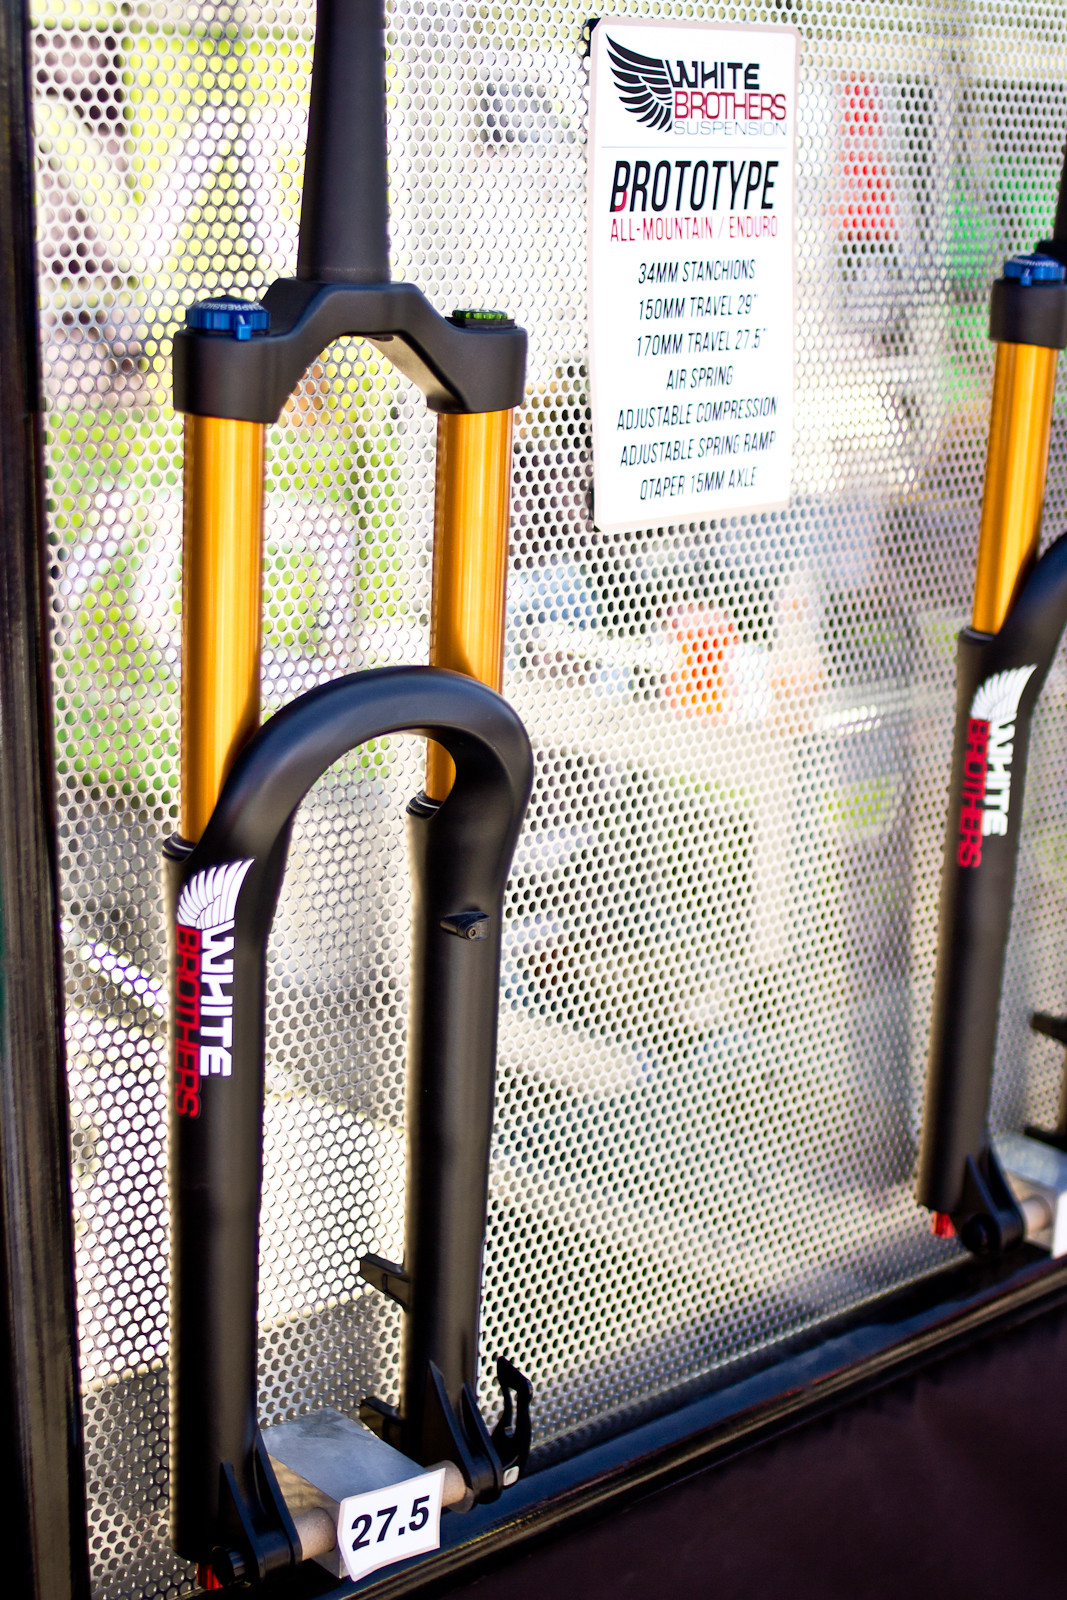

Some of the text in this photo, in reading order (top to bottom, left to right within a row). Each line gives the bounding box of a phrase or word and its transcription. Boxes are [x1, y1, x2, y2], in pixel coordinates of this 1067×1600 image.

[665, 60, 760, 90] WHITE
[674, 91, 787, 120] BROTHERS
[674, 120, 787, 136] SUSPENSION
[610, 217, 713, 242] ALL-MOUNTAIN
[729, 215, 778, 238] ENDURO
[638, 259, 756, 284] 34MM STANCHIONS
[639, 297, 686, 320] 150MM
[690, 295, 733, 317] TRAVEL
[637, 333, 683, 357] 170MM
[687, 330, 731, 354] TRAVEL
[666, 366, 734, 390] AIR SPRING
[617, 396, 778, 431] ADJUSTABLE COMPRESSION
[620, 430, 777, 467] ADJUSTABLE SPRING RAMP
[691, 470, 725, 493] 15MM
[728, 466, 758, 488] AXLE
[981, 714, 1016, 836] WHITE
[958, 718, 990, 867] BROTHERS
[200, 919, 235, 1077] WHITE
[174, 924, 200, 1117] BROTHERS
[351, 1495, 430, 1551] 27.5
